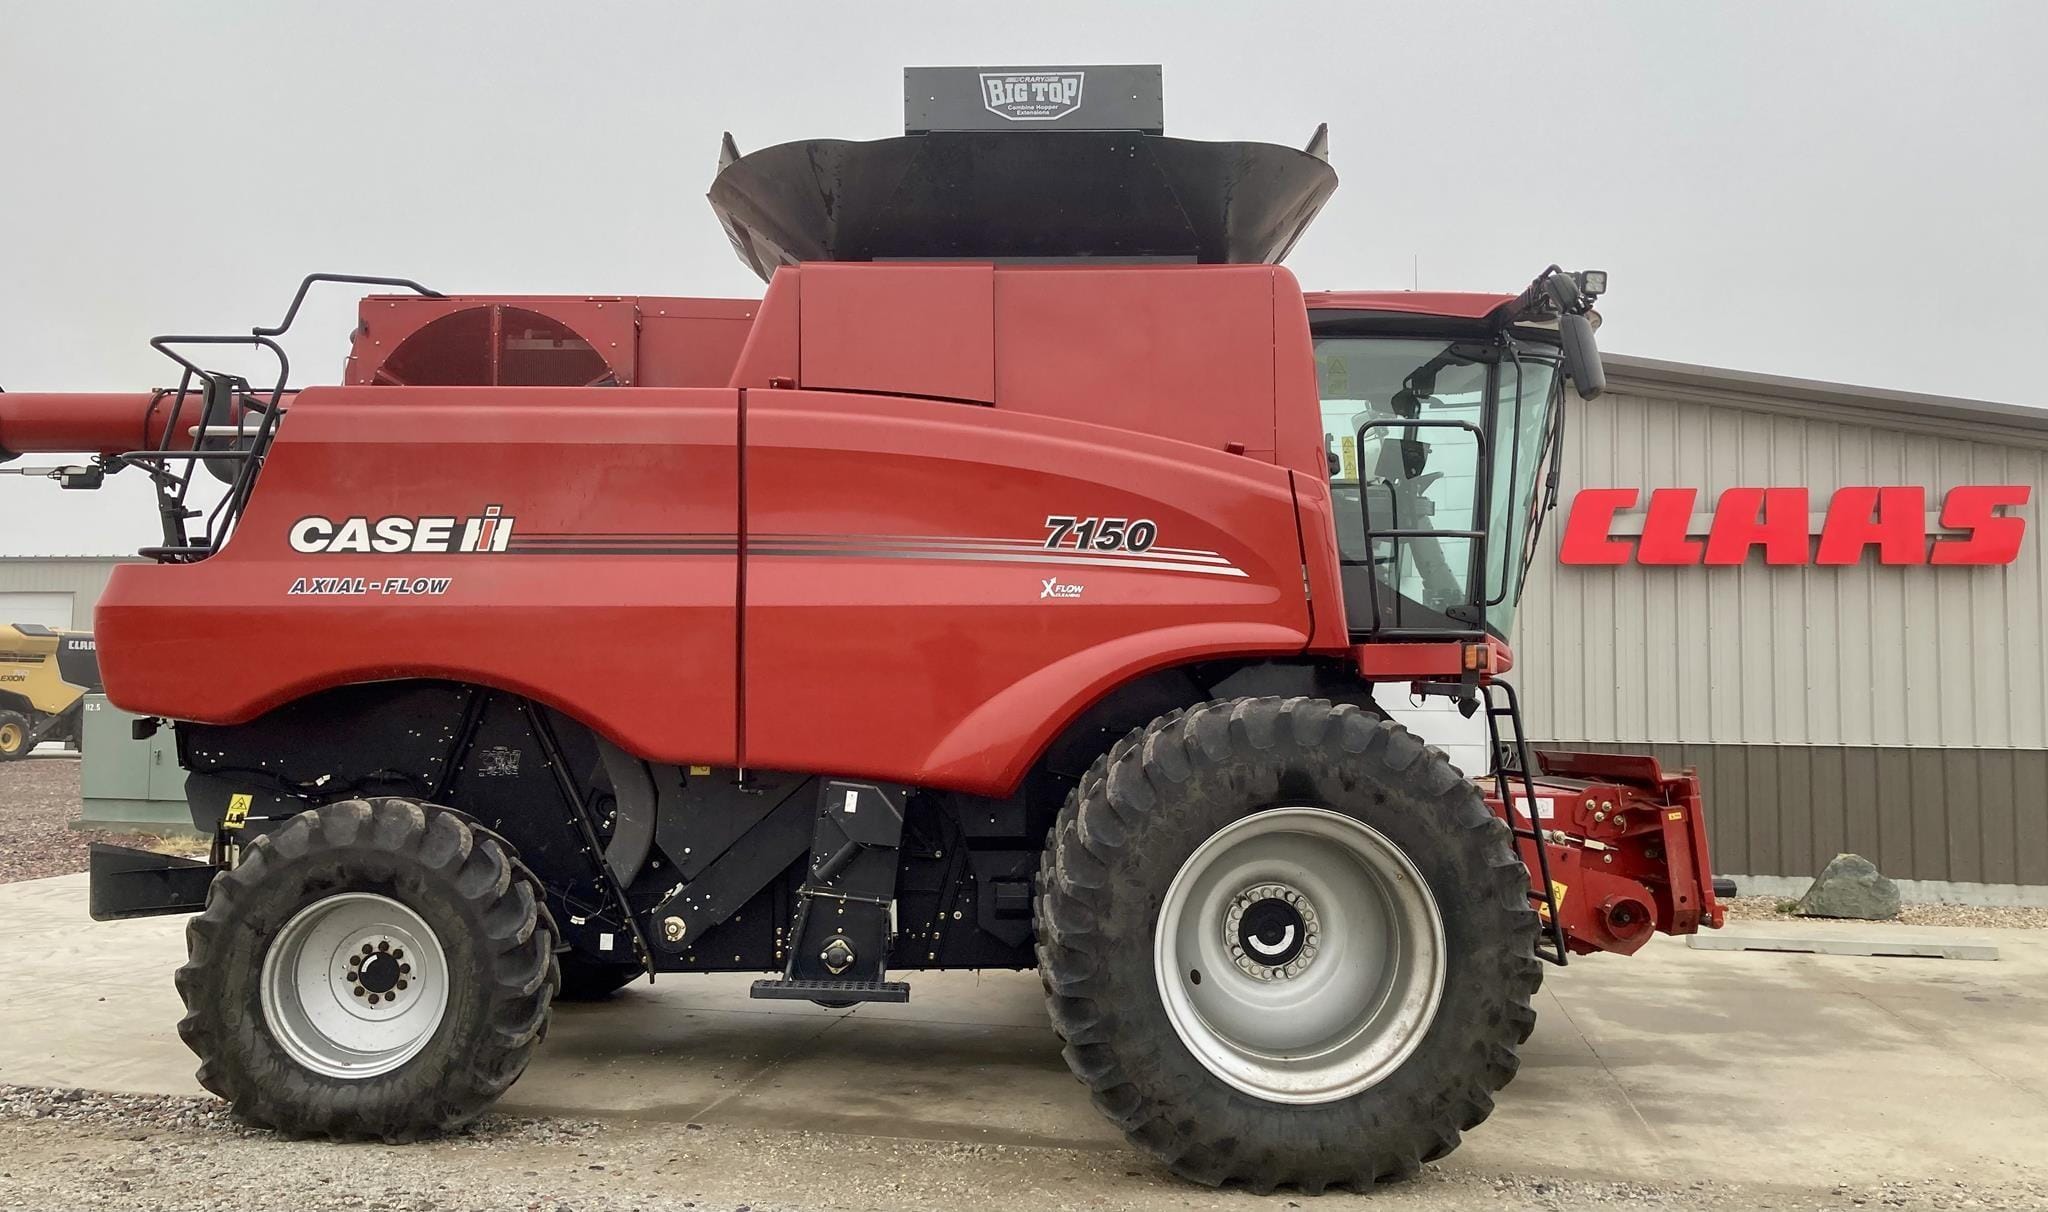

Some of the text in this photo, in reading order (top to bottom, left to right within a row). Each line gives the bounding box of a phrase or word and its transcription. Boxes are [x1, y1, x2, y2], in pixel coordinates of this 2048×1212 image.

[987, 78, 1077, 107] BIG TOP
[289, 516, 456, 553] CASE
[1044, 515, 1158, 553] 7150
[1559, 486, 2032, 566] CLAAS
[68, 640, 96, 650] CLAA
